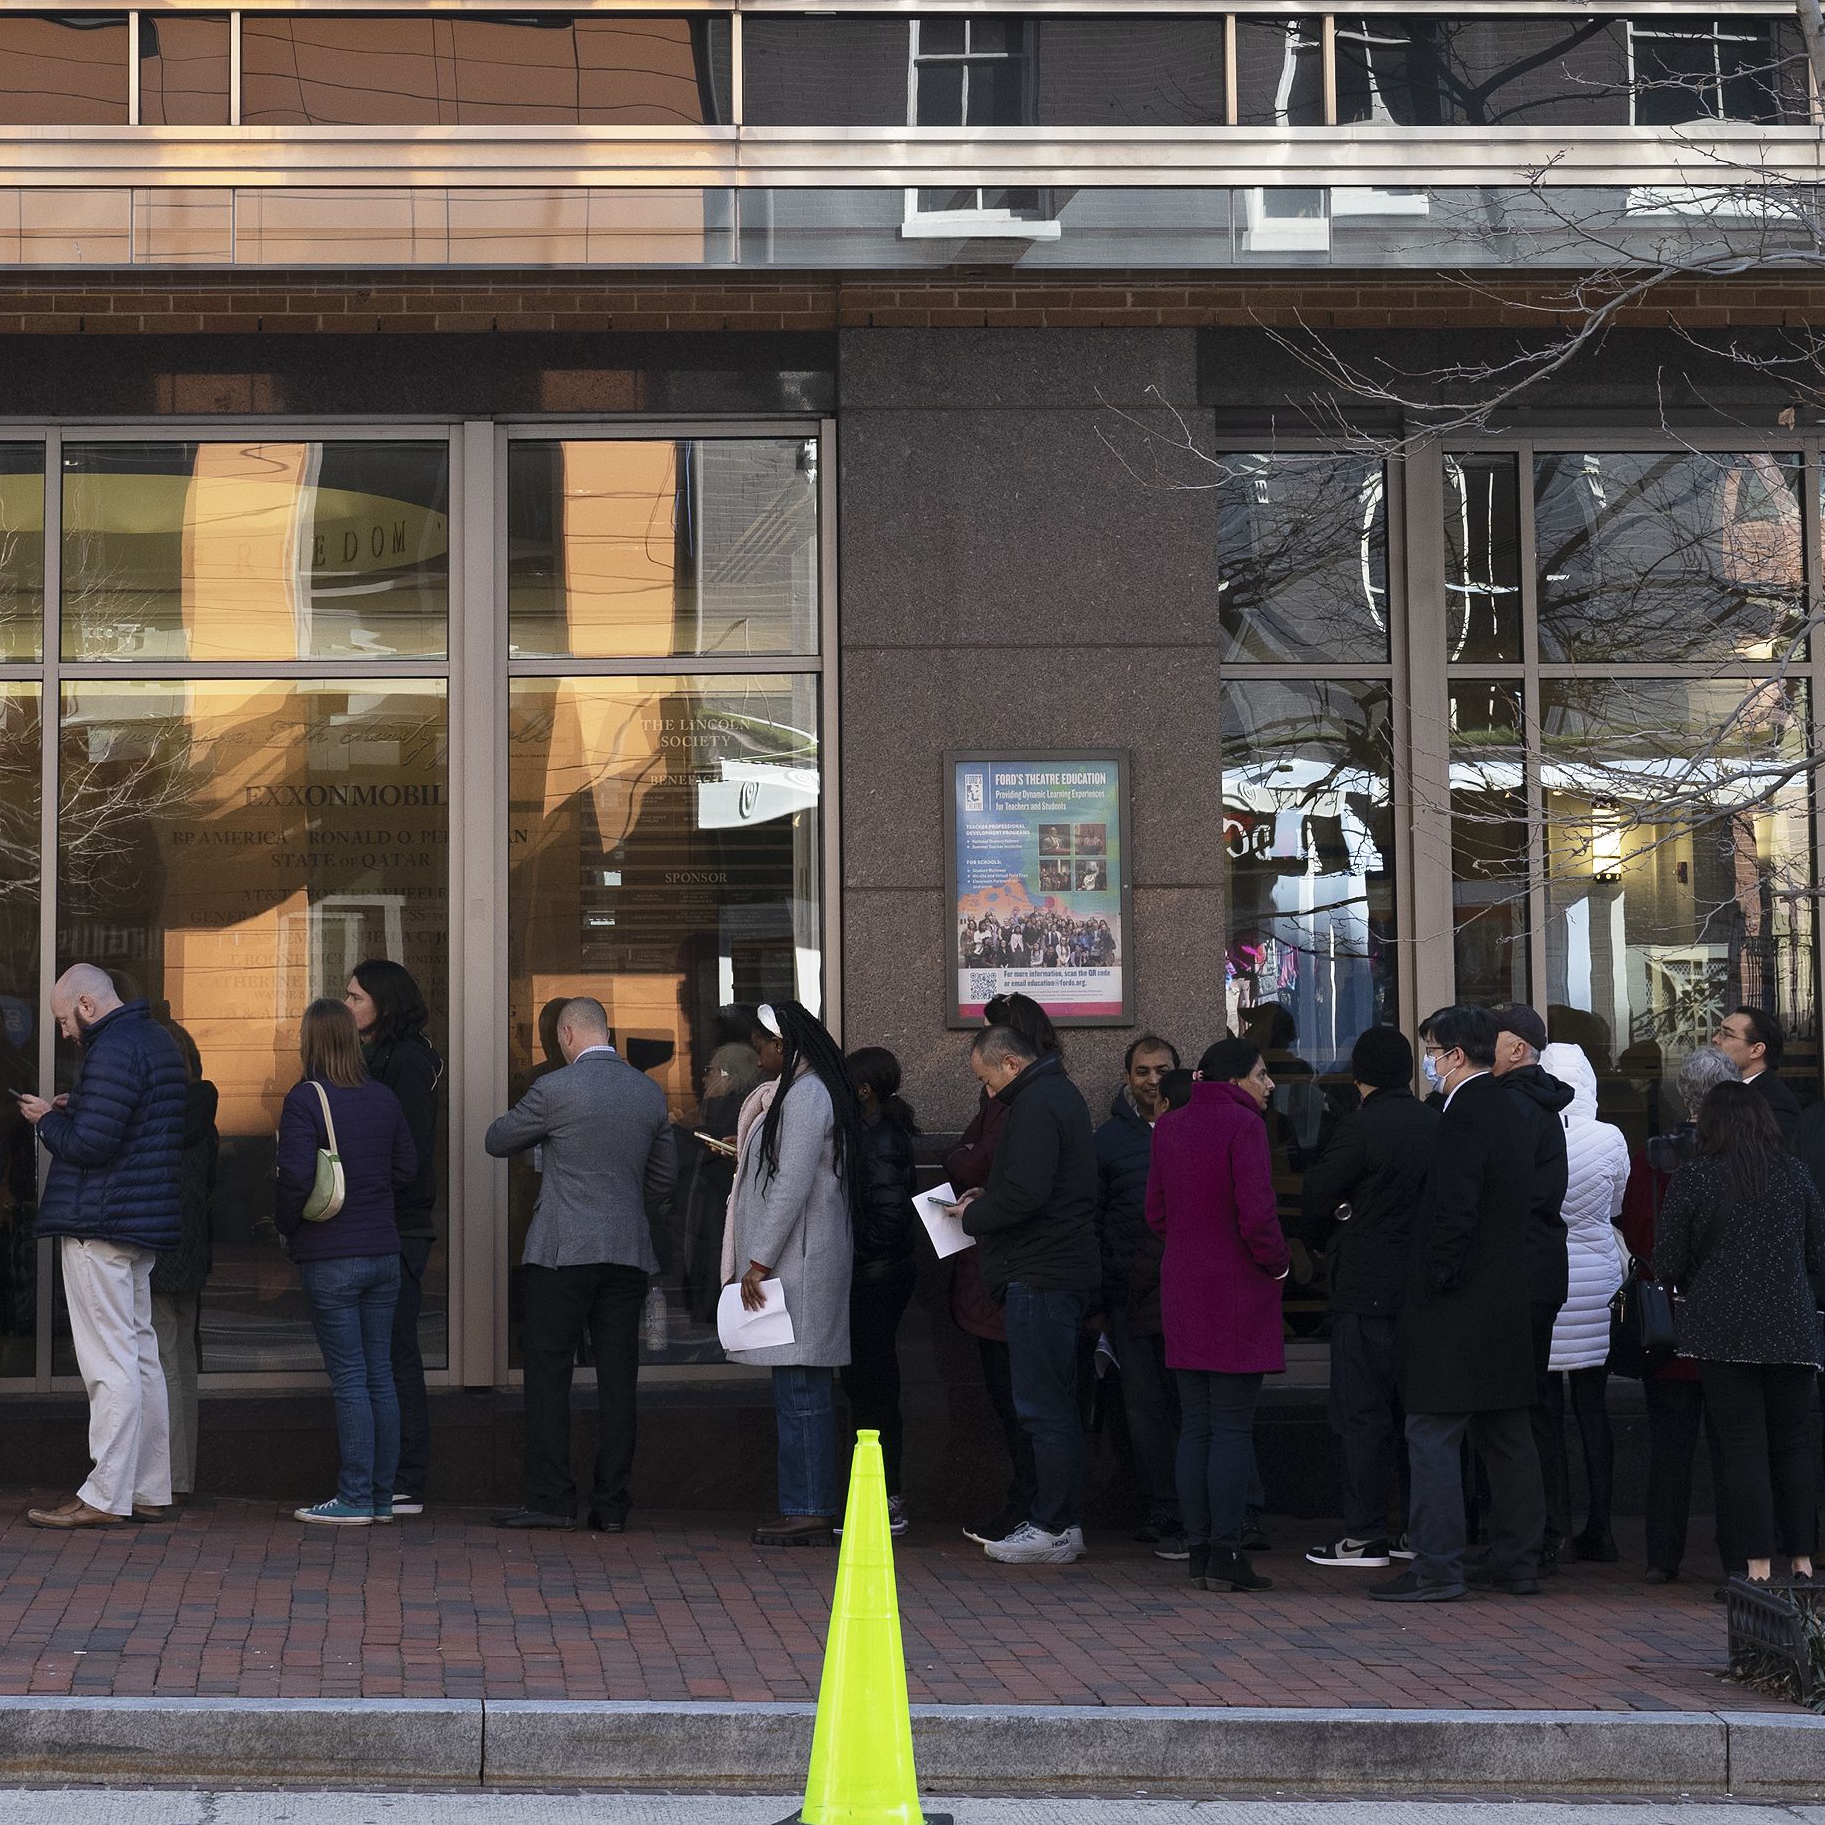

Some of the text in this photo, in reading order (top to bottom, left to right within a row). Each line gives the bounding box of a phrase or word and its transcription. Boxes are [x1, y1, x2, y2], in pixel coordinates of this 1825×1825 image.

[642, 718, 751, 732] THE LINCOLN
[661, 735, 732, 748] SOCIETY
[996, 772, 1106, 786] FORD'S THEATRE EDUCATION
[245, 784, 449, 807] EXXONMOBIL
[996, 788, 1105, 800] Providing Dynamic Learning Experiences
[996, 802, 1066, 811] for Teachers and Students
[200, 830, 288, 846] AMERICA
[309, 830, 392, 846] RONALD
[270, 852, 335, 868] STATE
[362, 852, 431, 869] QATAR
[665, 872, 728, 884] SPONSOR
[1030, 970, 1063, 978] information,
